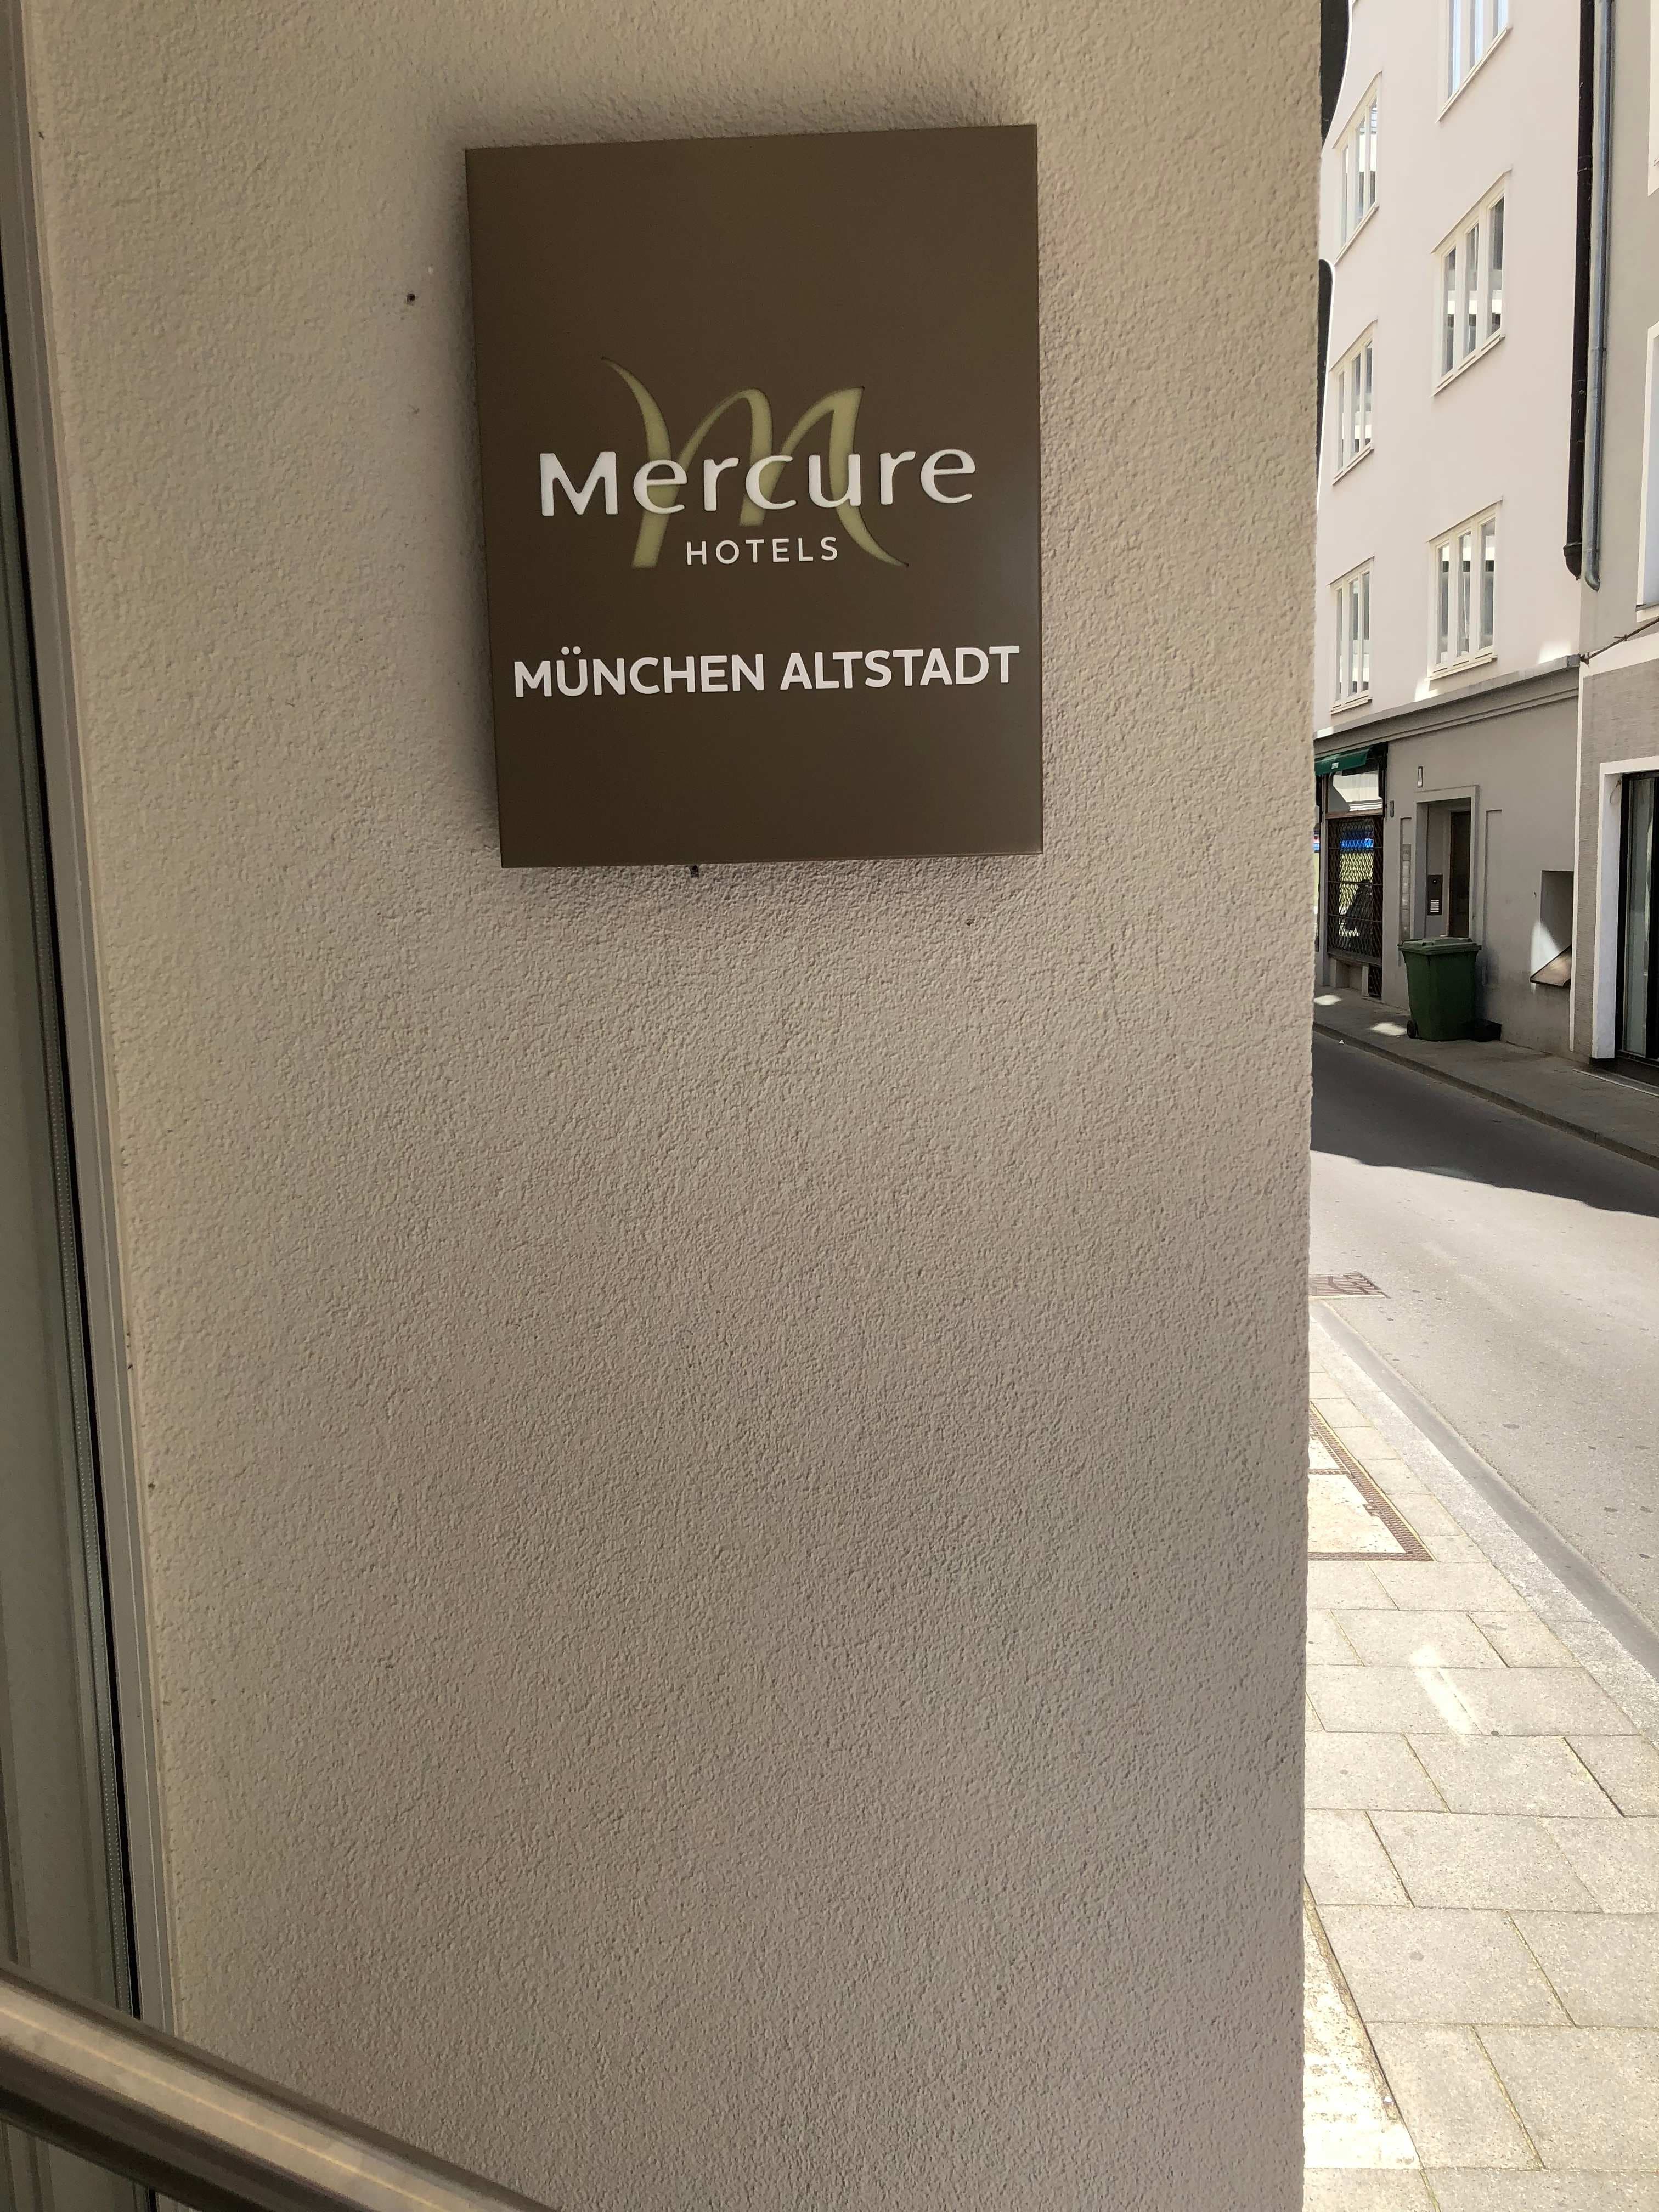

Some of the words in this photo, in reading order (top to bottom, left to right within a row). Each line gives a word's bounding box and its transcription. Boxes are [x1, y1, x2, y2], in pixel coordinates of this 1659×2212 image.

[539, 448, 976, 517] Mercure
[686, 536, 838, 566] HOTELS
[514, 646, 765, 698] MÜNCHEN
[780, 645, 1020, 691] ALTSTADT
